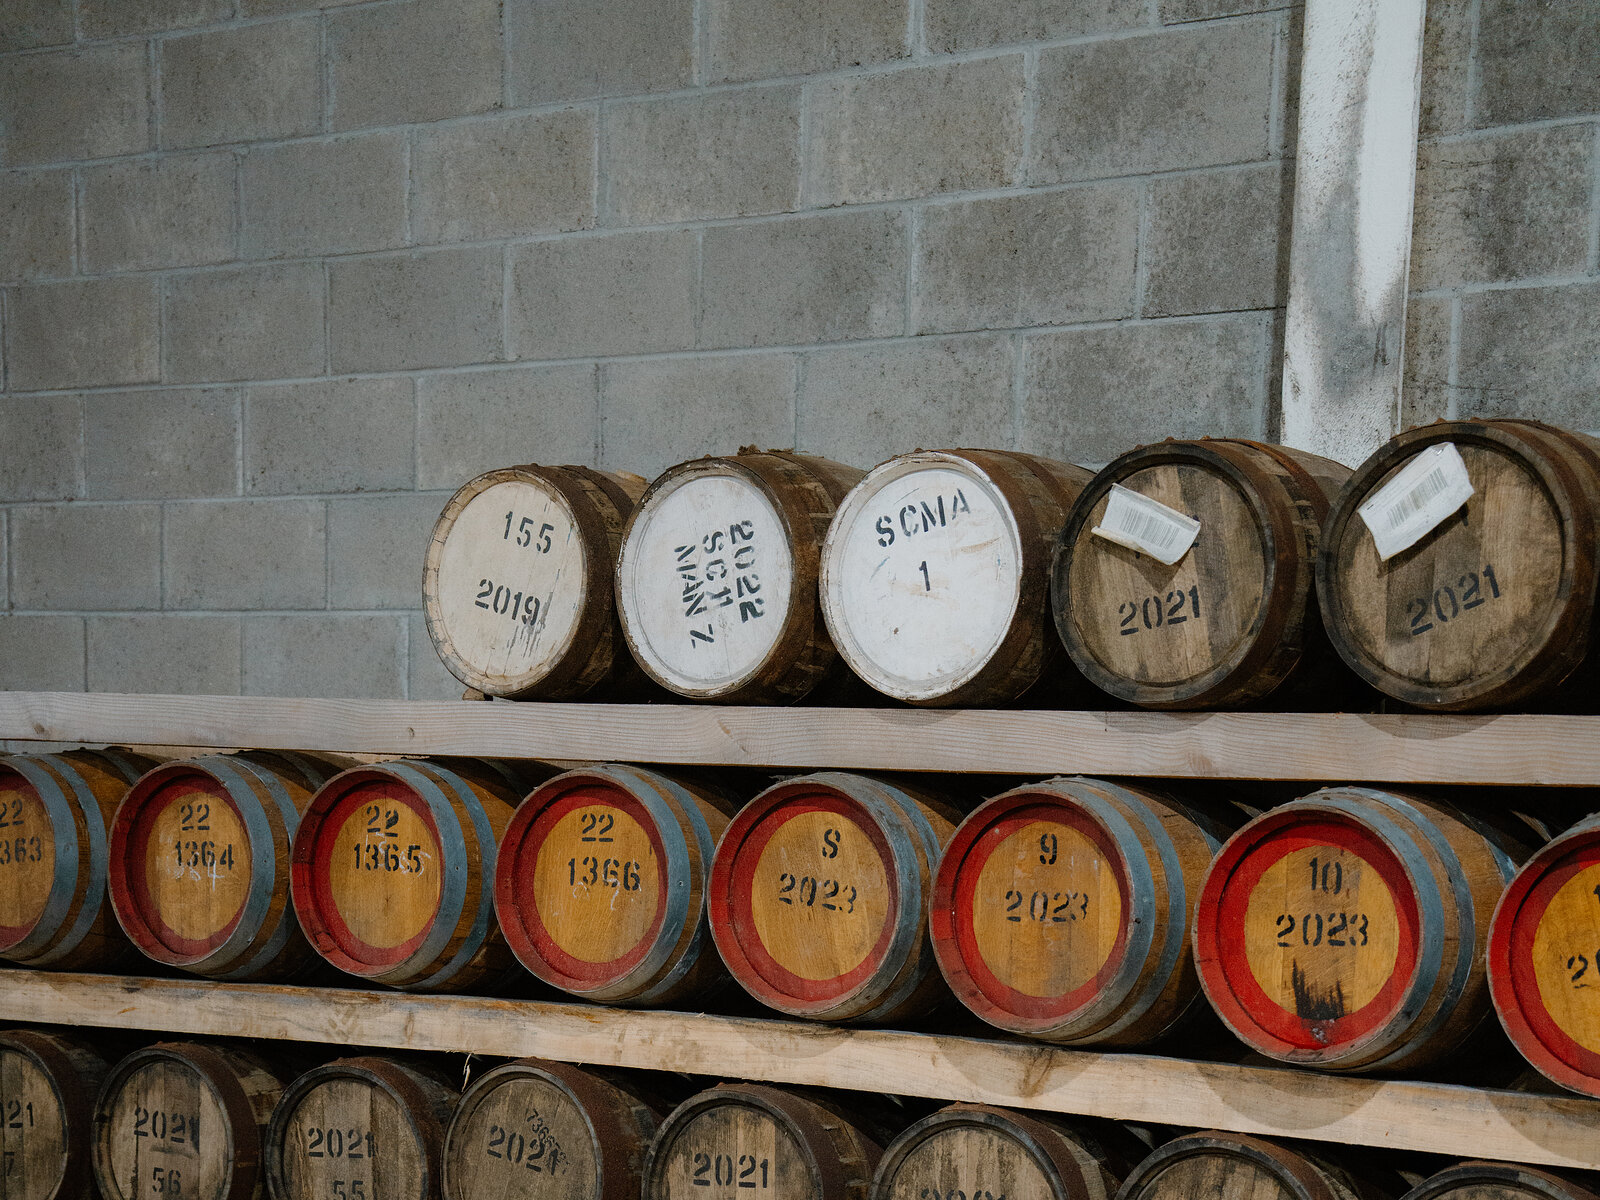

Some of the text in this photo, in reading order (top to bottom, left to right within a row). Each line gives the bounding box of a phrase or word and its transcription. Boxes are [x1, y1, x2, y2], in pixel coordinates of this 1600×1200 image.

[503, 510, 554, 553] 155
[730, 519, 765, 624] 2022
[919, 560, 931, 592] 1
[475, 579, 541, 626] 2019
[1118, 585, 1200, 636] 2021
[1406, 564, 1500, 636] 2021
[181, 803, 211, 832] 22
[366, 805, 399, 838] 22
[580, 813, 615, 842] 22
[175, 840, 235, 871] 1364
[353, 843, 421, 874] 1365
[1039, 833, 1058, 866] 9
[568, 856, 641, 892] 1366
[1309, 857, 1343, 895] 10
[779, 873, 857, 915] 2023
[1005, 890, 1089, 923] 2023
[1276, 912, 1369, 947] 2023
[134, 1107, 199, 1144] 2021
[308, 1127, 375, 1159] 2021
[487, 1124, 559, 1176] 2021
[151, 1166, 182, 1195] 56
[692, 1152, 769, 1189] 2021
